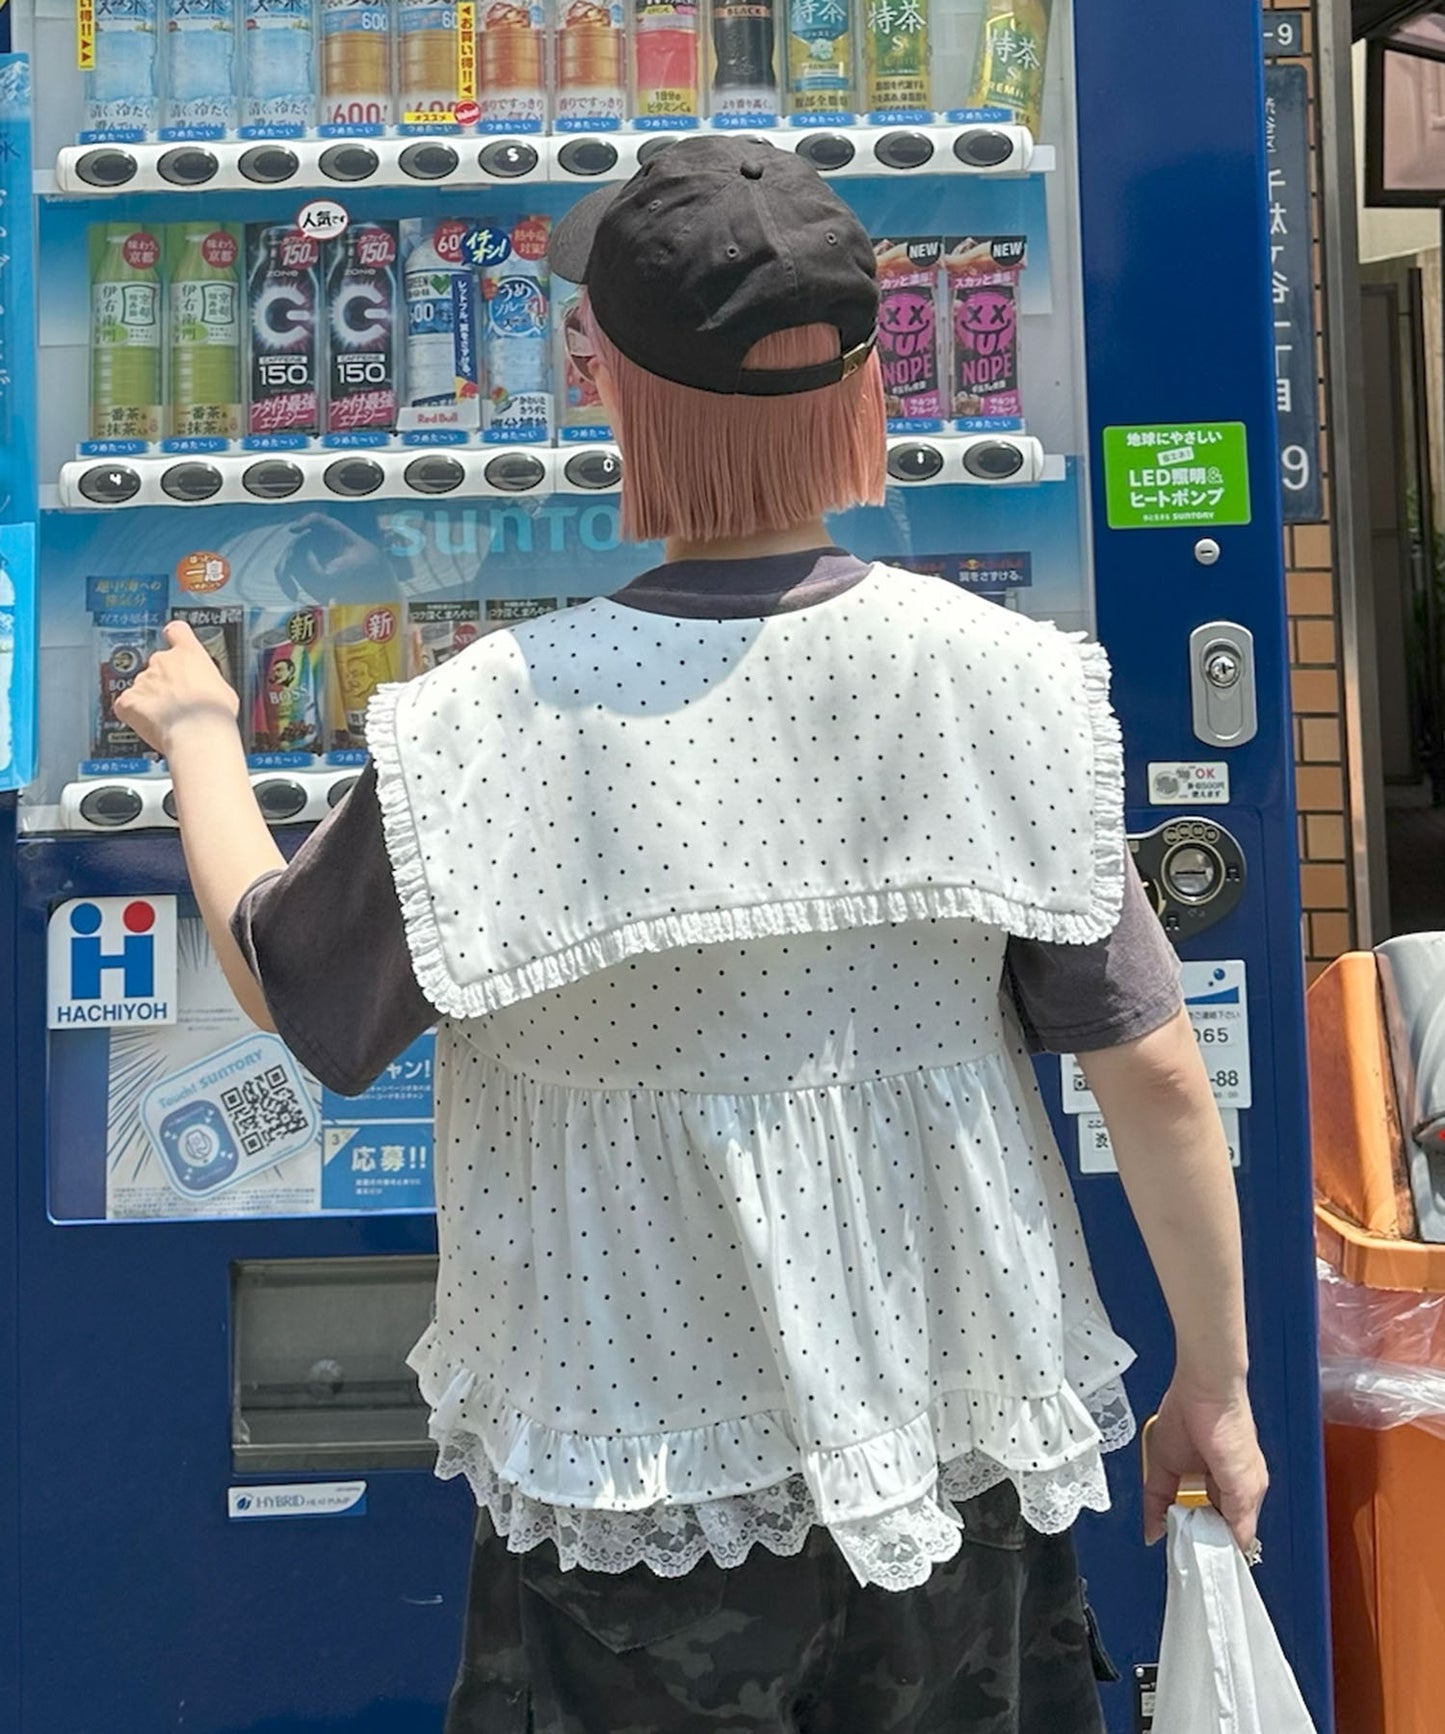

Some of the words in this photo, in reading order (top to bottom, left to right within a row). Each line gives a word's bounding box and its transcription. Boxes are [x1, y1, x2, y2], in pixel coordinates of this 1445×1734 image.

[361, 13, 388, 30] 600
[442, 13, 457, 30] 60
[726, 7, 762, 16] BLACK
[868, 0, 927, 34] 特茶
[460, 18, 474, 83] お買い得!!
[992, 29, 1041, 70] 特茶
[437, 233, 466, 253] 60
[909, 242, 939, 258] NEW
[992, 241, 1023, 258] NEW
[129, 252, 154, 264] 京都
[208, 250, 233, 262] 京都
[499, 282, 532, 302] うめ
[259, 364, 308, 385] 150
[337, 363, 386, 384] 150
[882, 353, 933, 386] NOPE
[962, 352, 1013, 386] NOPE
[251, 391, 317, 418] フタ付最強
[329, 391, 394, 418] フタ付最強
[417, 414, 437, 424] Red
[438, 412, 458, 422] Bull
[1126, 429, 1223, 447] 地球にやさしい
[1128, 466, 1225, 488] LED照明&
[1281, 444, 1310, 491] 9
[1129, 486, 1226, 509] ヒートポンプ
[1172, 510, 1215, 521] SUNTORY
[291, 613, 314, 640] 新
[368, 611, 394, 640] 新
[268, 682, 310, 705] BOSS
[336, 753, 364, 762] つめた
[1195, 767, 1216, 780] OK
[57, 1001, 168, 1023] HACHIYOH
[198, 1048, 264, 1089] SUNTORY
[331, 1133, 341, 1146] 3
[351, 1144, 427, 1172] 応募!!
[255, 1494, 305, 1509] HYBRID
